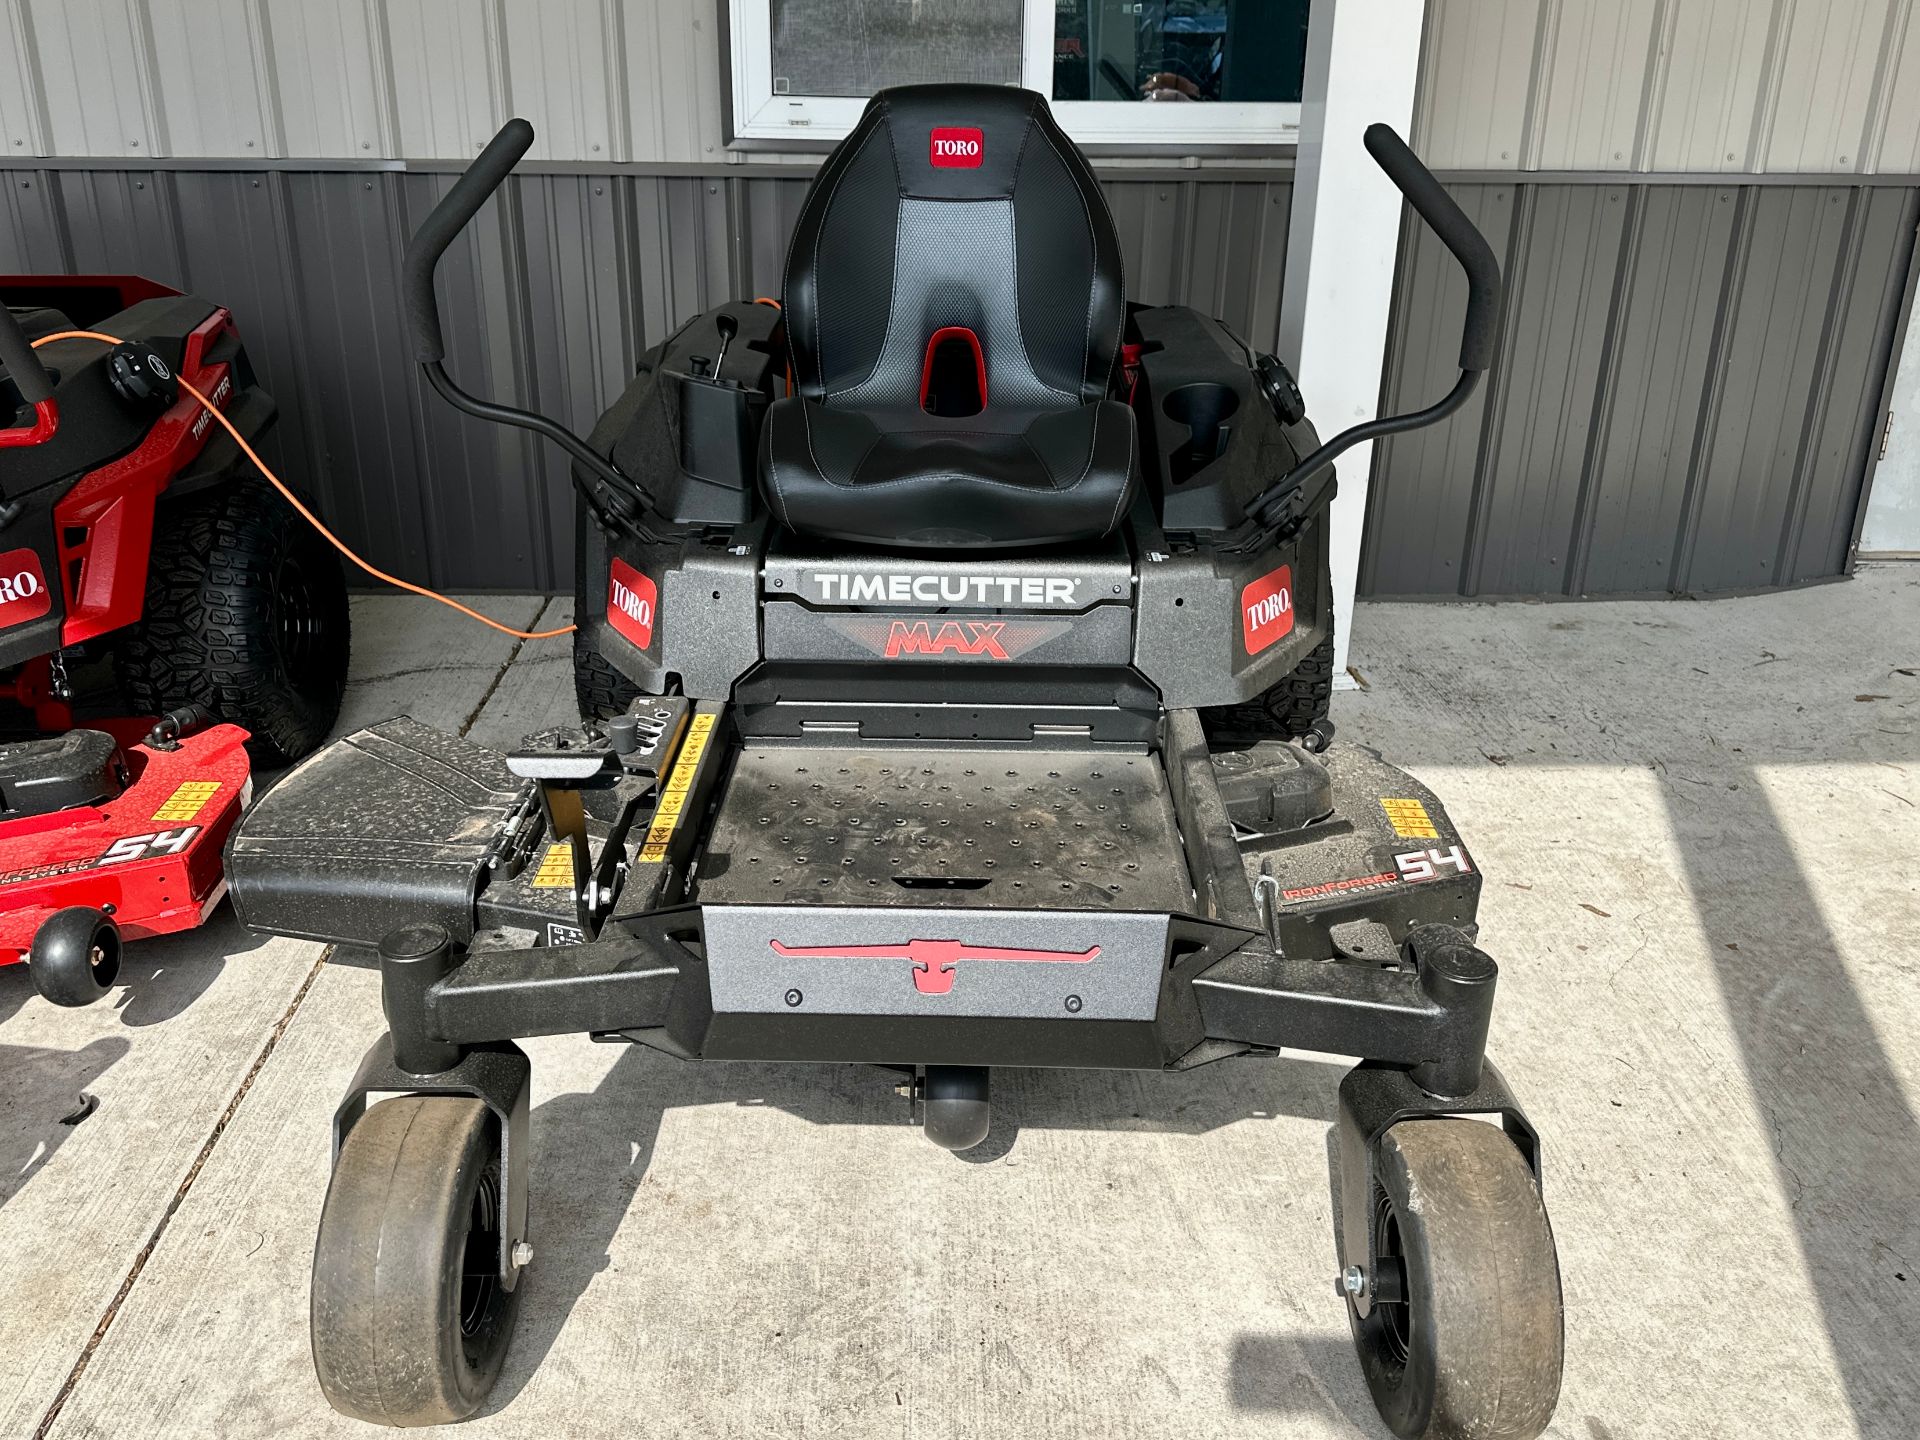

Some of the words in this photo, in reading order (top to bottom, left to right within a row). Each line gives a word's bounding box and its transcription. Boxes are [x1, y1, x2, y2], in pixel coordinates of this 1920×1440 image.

[934, 139, 979, 156] TORO
[612, 578, 651, 627] TORO
[814, 573, 1077, 604] TIMECUTTER
[1246, 587, 1289, 632] TORO
[884, 621, 1010, 659] MAX
[98, 826, 201, 867] 54
[1394, 845, 1473, 883] 54
[28, 864, 89, 880] SYSTEM
[1350, 879, 1399, 893] SYSTEM
